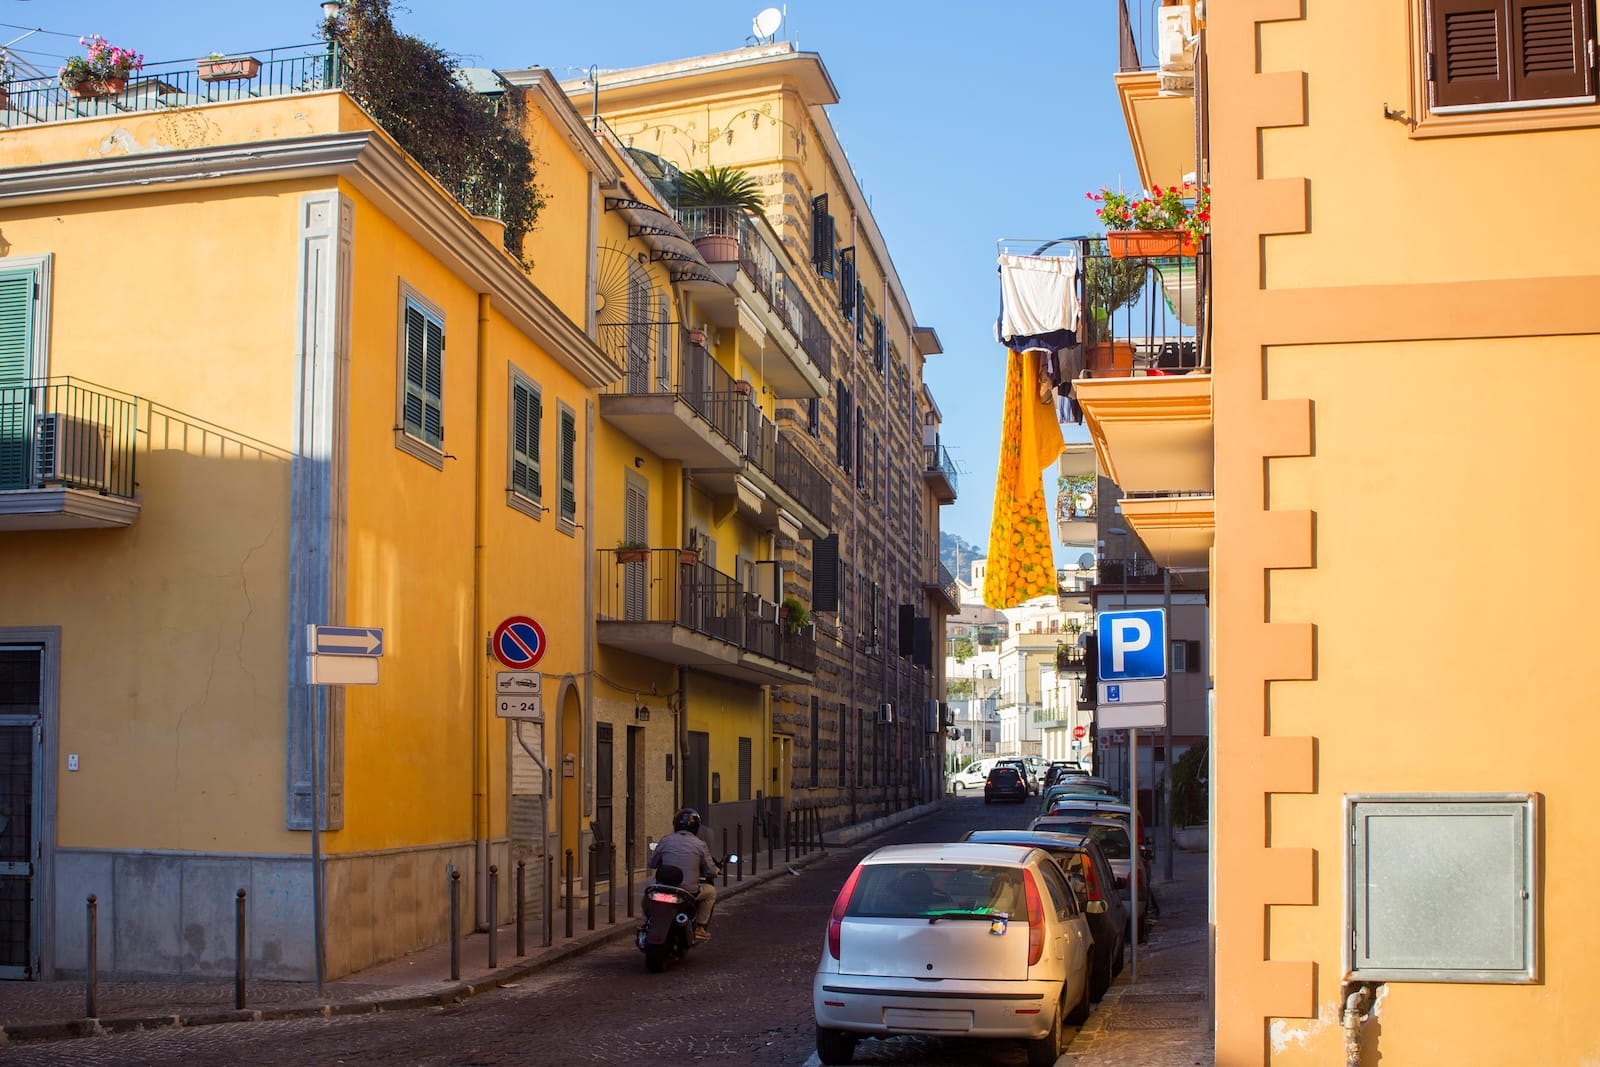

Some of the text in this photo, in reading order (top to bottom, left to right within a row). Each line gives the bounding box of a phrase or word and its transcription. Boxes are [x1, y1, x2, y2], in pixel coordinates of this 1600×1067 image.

[1112, 618, 1151, 672] P
[501, 702, 508, 711] 0
[520, 702, 535, 711] 24
